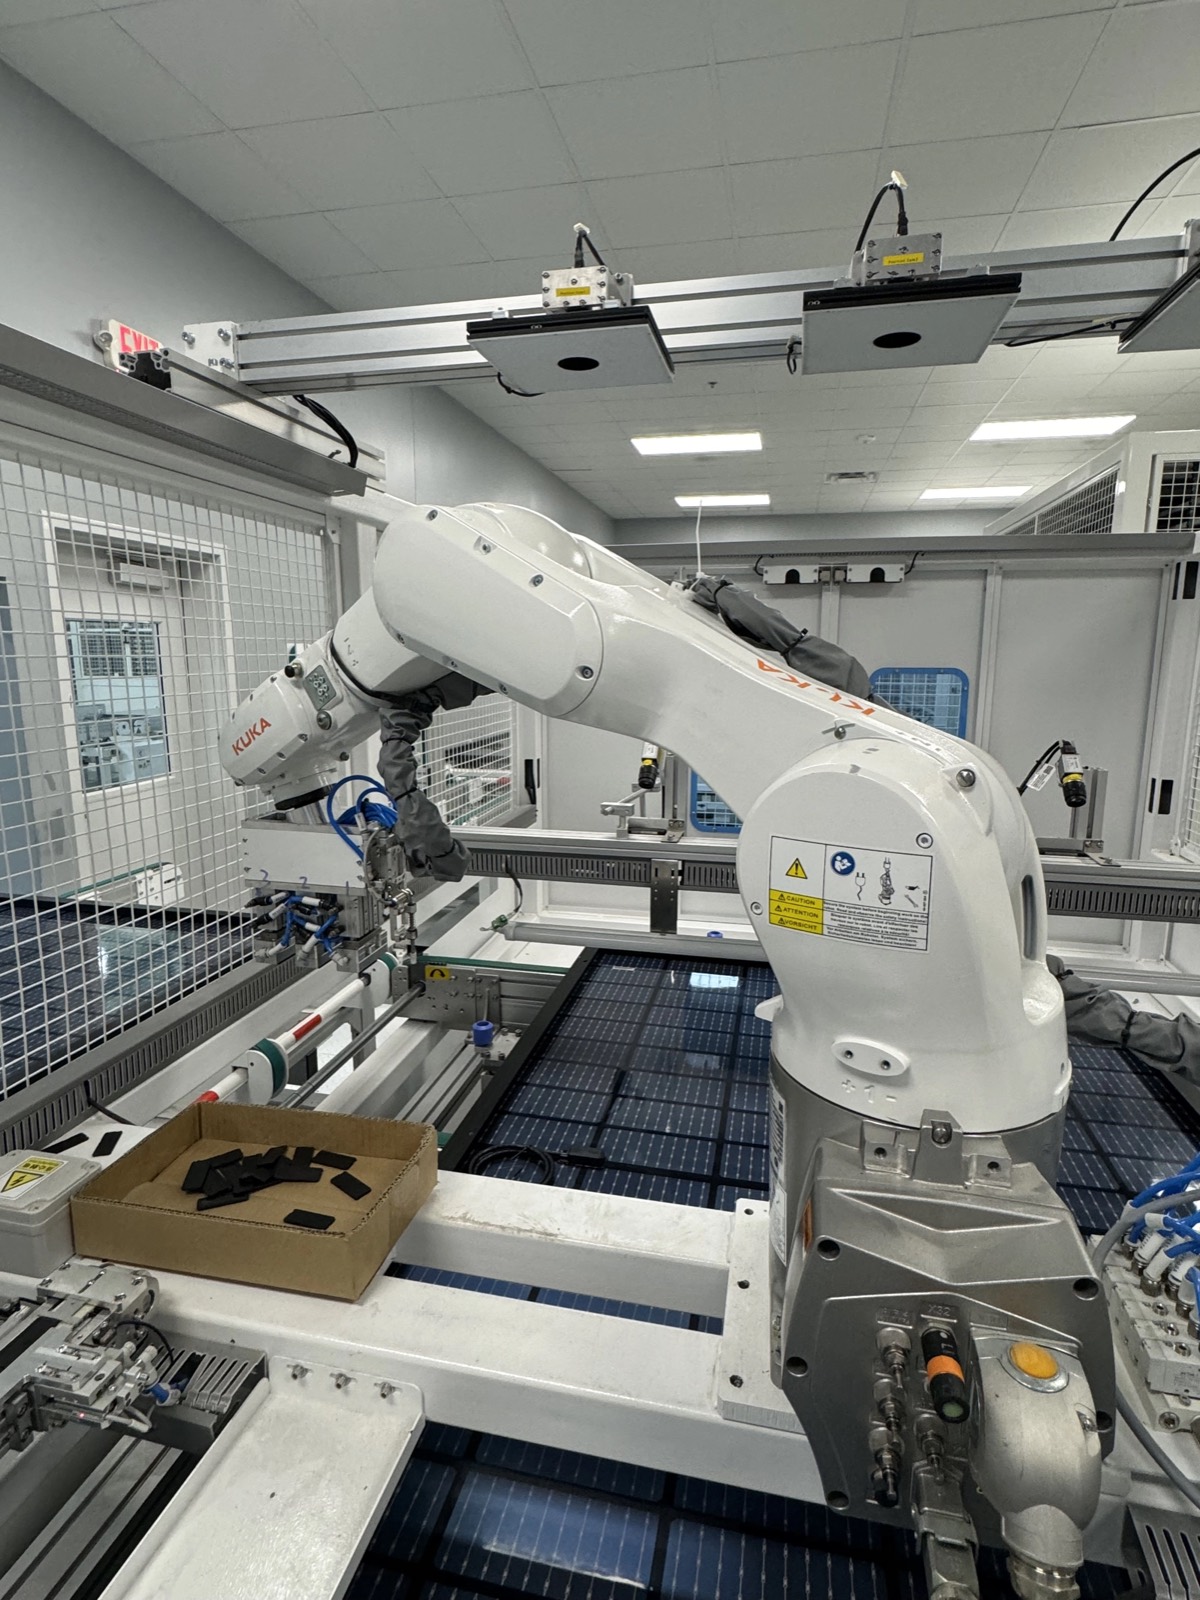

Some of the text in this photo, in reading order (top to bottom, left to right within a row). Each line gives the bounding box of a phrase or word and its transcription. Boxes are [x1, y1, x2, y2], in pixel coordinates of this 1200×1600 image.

[231, 717, 272, 756] KUKA
[299, 876, 310, 889] 2
[786, 895, 816, 905] CAUTION
[783, 907, 819, 918] ATTENTION
[784, 919, 817, 930] VORSICHT
[928, 1304, 952, 1317] X32
